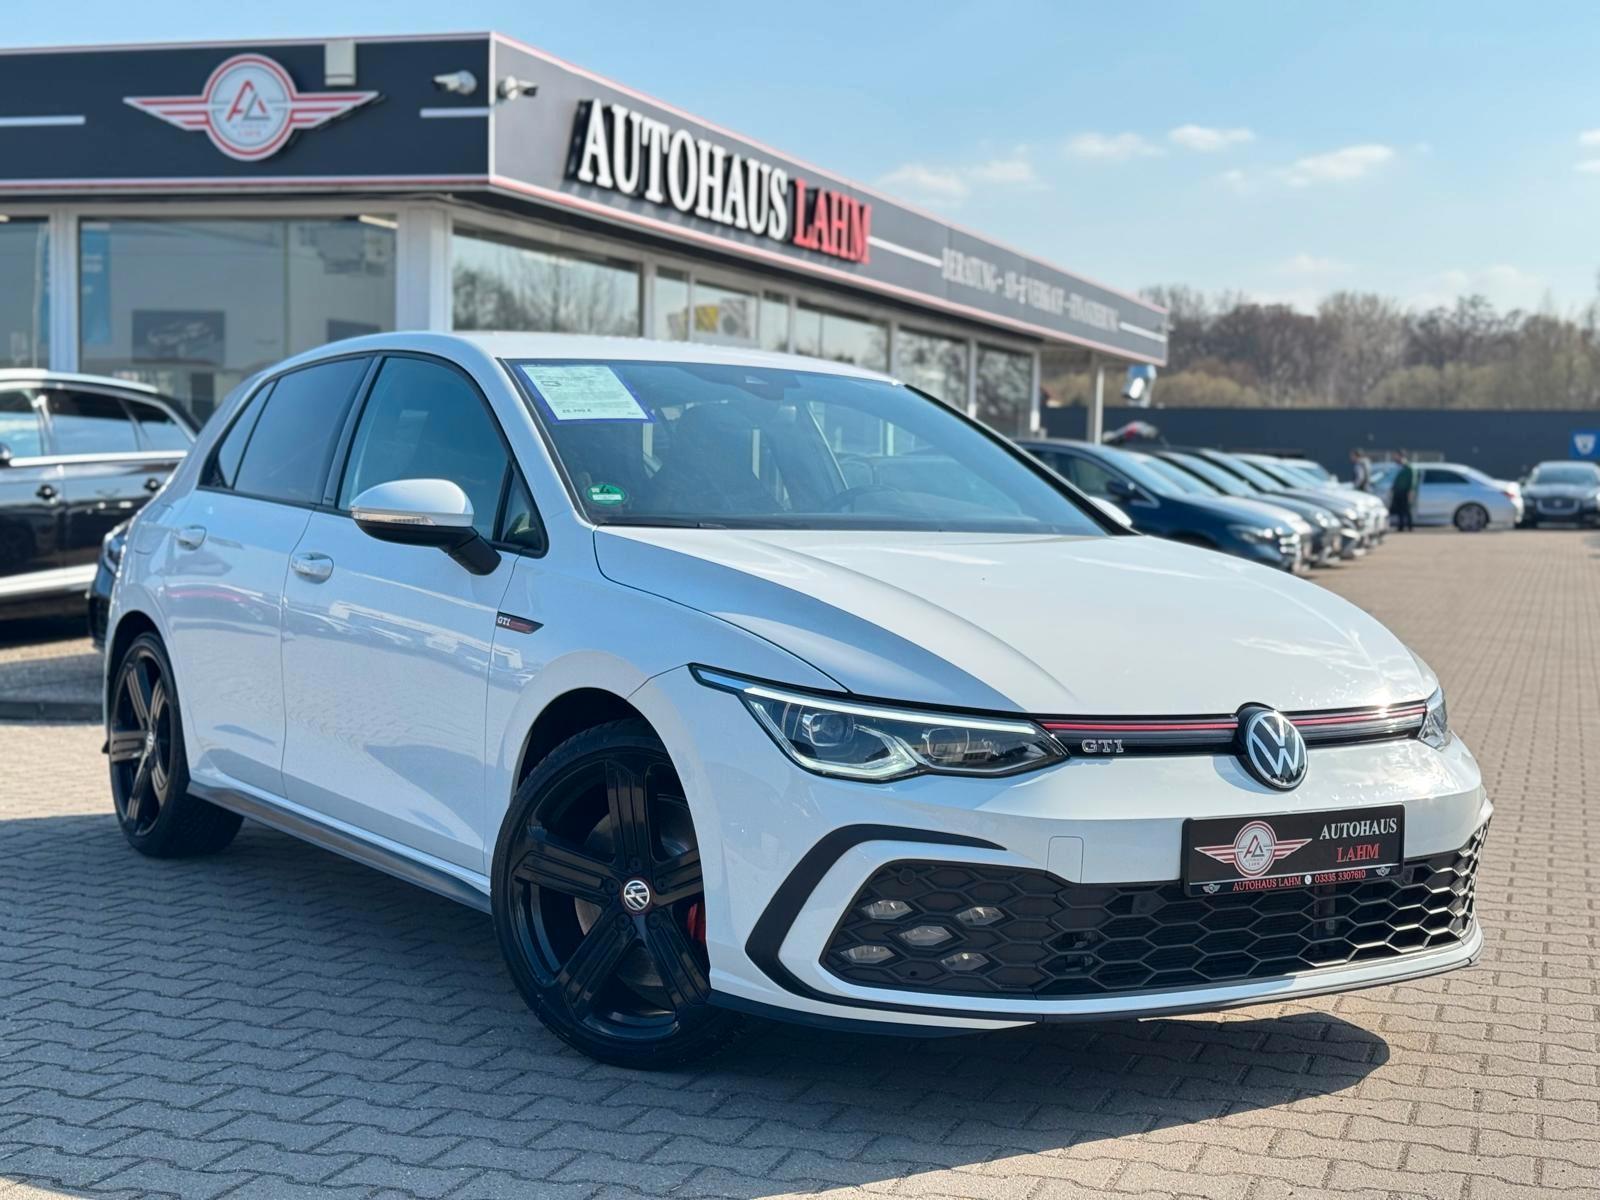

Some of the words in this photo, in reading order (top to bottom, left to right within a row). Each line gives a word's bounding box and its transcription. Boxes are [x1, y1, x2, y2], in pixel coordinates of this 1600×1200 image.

[578, 98, 788, 240] AUTOHAUS
[793, 178, 872, 264] LAHM
[497, 616, 511, 626] GTI
[1081, 739, 1125, 754] GTI
[1320, 818, 1397, 840] AUTOHAUS
[1336, 843, 1380, 863] LAHM
[1233, 878, 1277, 892] AUTOHAUS
[1278, 876, 1302, 887] LAHM
[1314, 872, 1337, 883] 03335
[1338, 869, 1366, 880] 3307610
